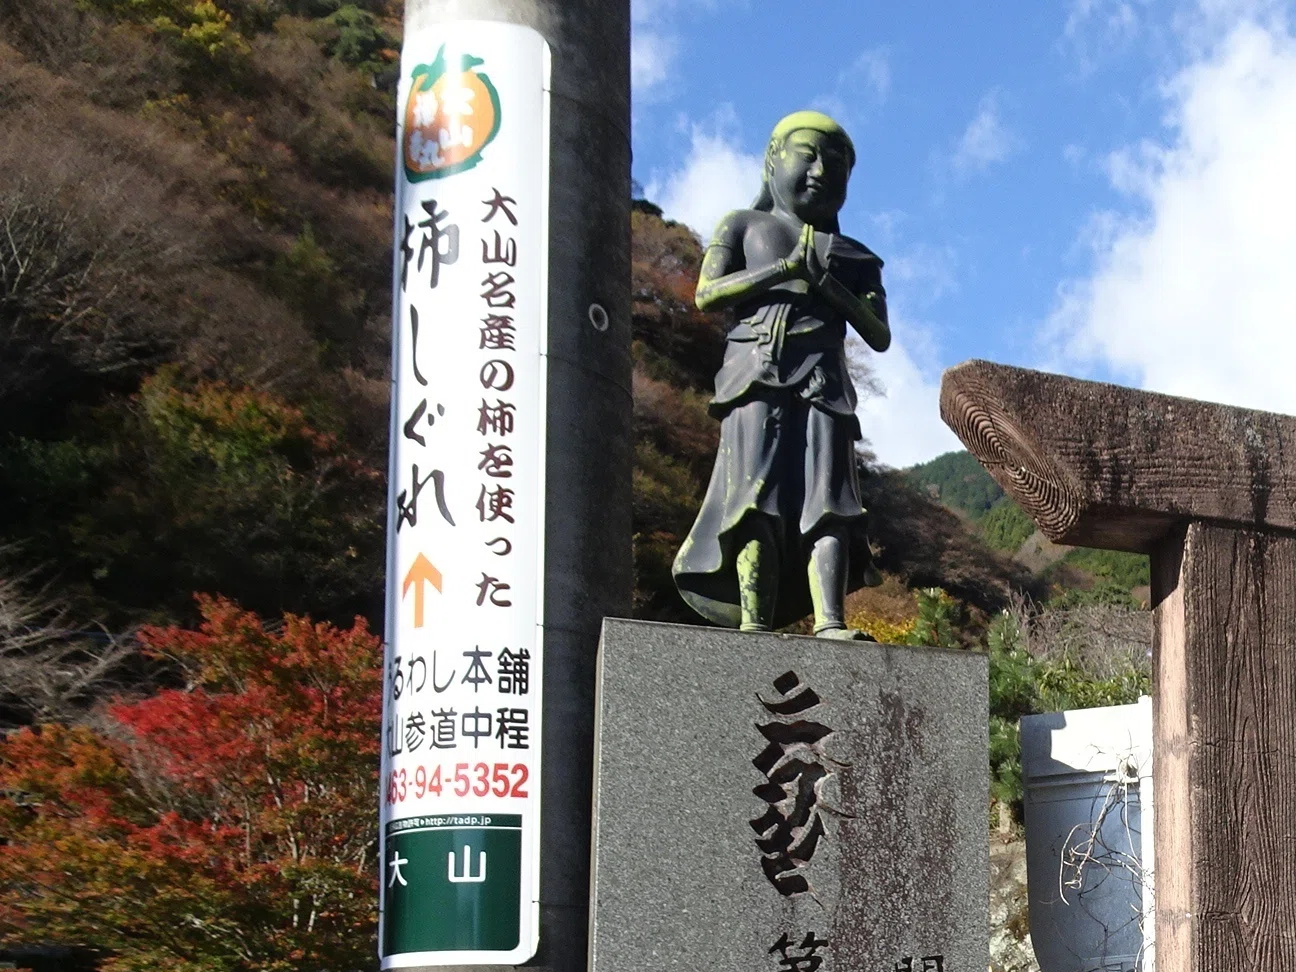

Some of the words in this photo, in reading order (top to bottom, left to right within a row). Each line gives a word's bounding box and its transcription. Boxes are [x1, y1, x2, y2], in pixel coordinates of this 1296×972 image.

[396, 199, 459, 533] 柿しぐれ
[475, 187, 518, 608] 大山名産の柿を使った
[388, 645, 531, 701] るわし本舗
[387, 705, 530, 757] 山参道中程
[388, 762, 529, 805] 63-94-5352
[425, 816, 492, 827] http://tadp.jp
